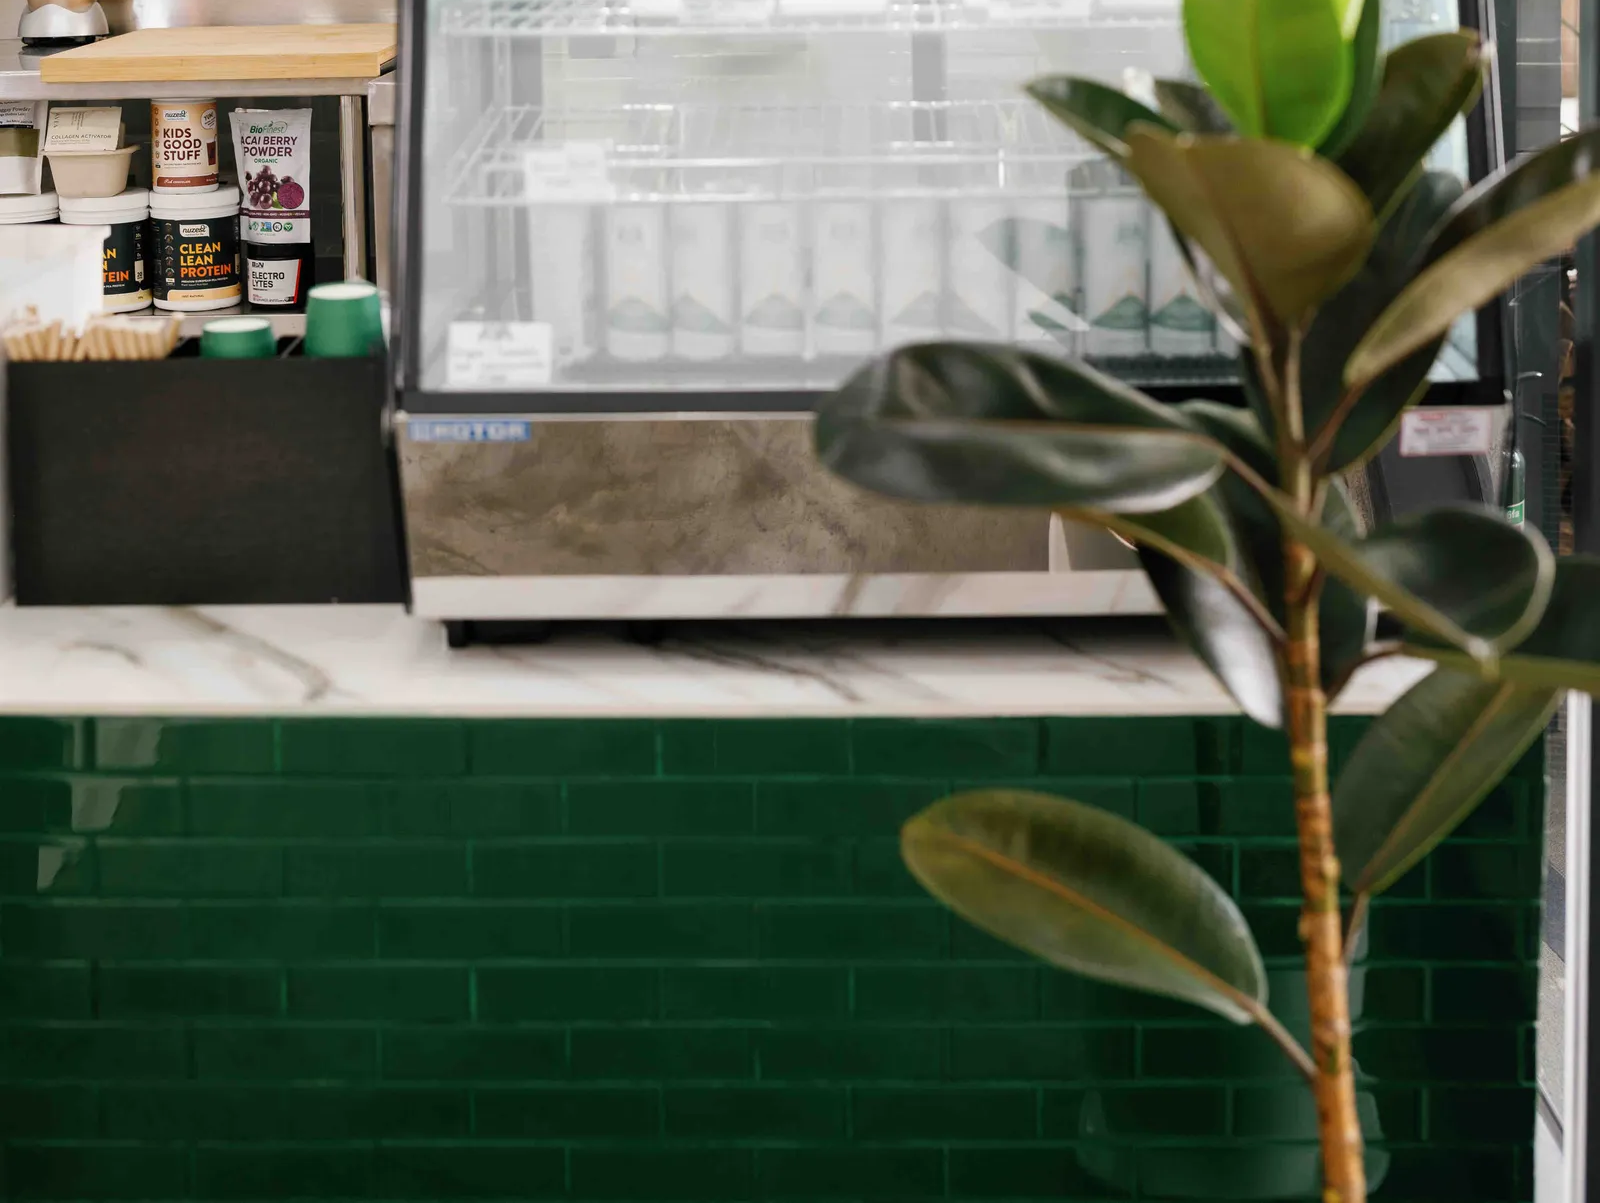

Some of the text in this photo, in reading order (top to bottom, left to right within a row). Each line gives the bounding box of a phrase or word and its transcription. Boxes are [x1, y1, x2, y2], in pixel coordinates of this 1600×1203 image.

[164, 128, 191, 138] KIDS
[164, 139, 202, 149] GOOD
[241, 136, 298, 145] ACAI BERRY
[164, 150, 200, 160] STUFF
[244, 147, 292, 157] POWDER
[180, 242, 220, 255] CLEAN
[180, 255, 213, 266] LEAN
[180, 264, 231, 278] PROTEIN
[252, 271, 284, 280] ELECTRO
